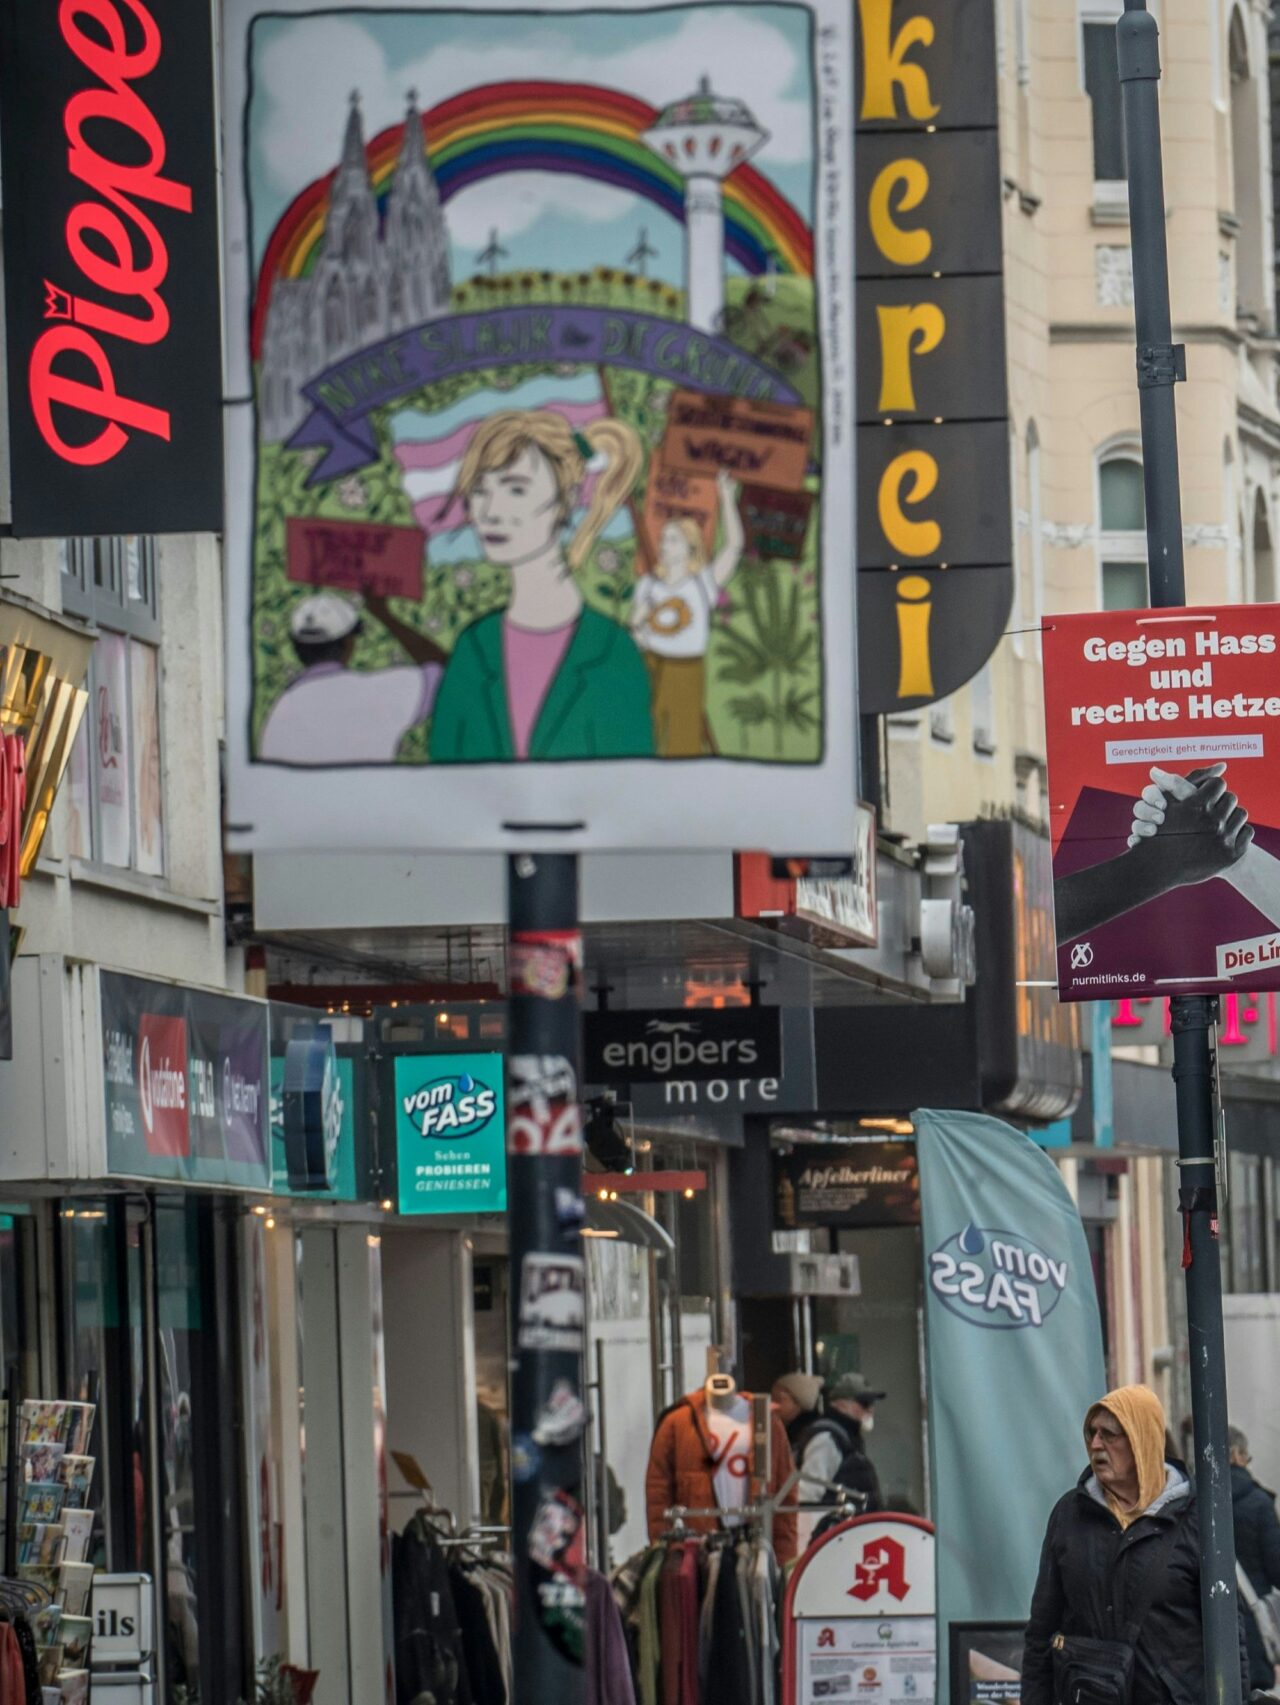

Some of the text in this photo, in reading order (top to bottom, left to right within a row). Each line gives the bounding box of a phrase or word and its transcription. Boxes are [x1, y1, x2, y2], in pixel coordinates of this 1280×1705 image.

[1083, 631, 1277, 667] Gegen Hass
[1150, 661, 1213, 690] und
[1070, 696, 1180, 726] rechte
[1111, 740, 1258, 757] Gerechtigkeit geht #nurmitlinks
[1224, 945, 1255, 970] Die
[1072, 971, 1147, 987] nurmitlinks.de
[602, 1030, 759, 1073] engbers
[403, 1082, 453, 1114] vom
[664, 1076, 780, 1103] more
[421, 1089, 496, 1137] FASS
[415, 1163, 491, 1177] PROBIEREN
[798, 1166, 911, 1189] Apfelberliner
[415, 1178, 491, 1192] GENIESSEN
[93, 1609, 135, 1637] ils
